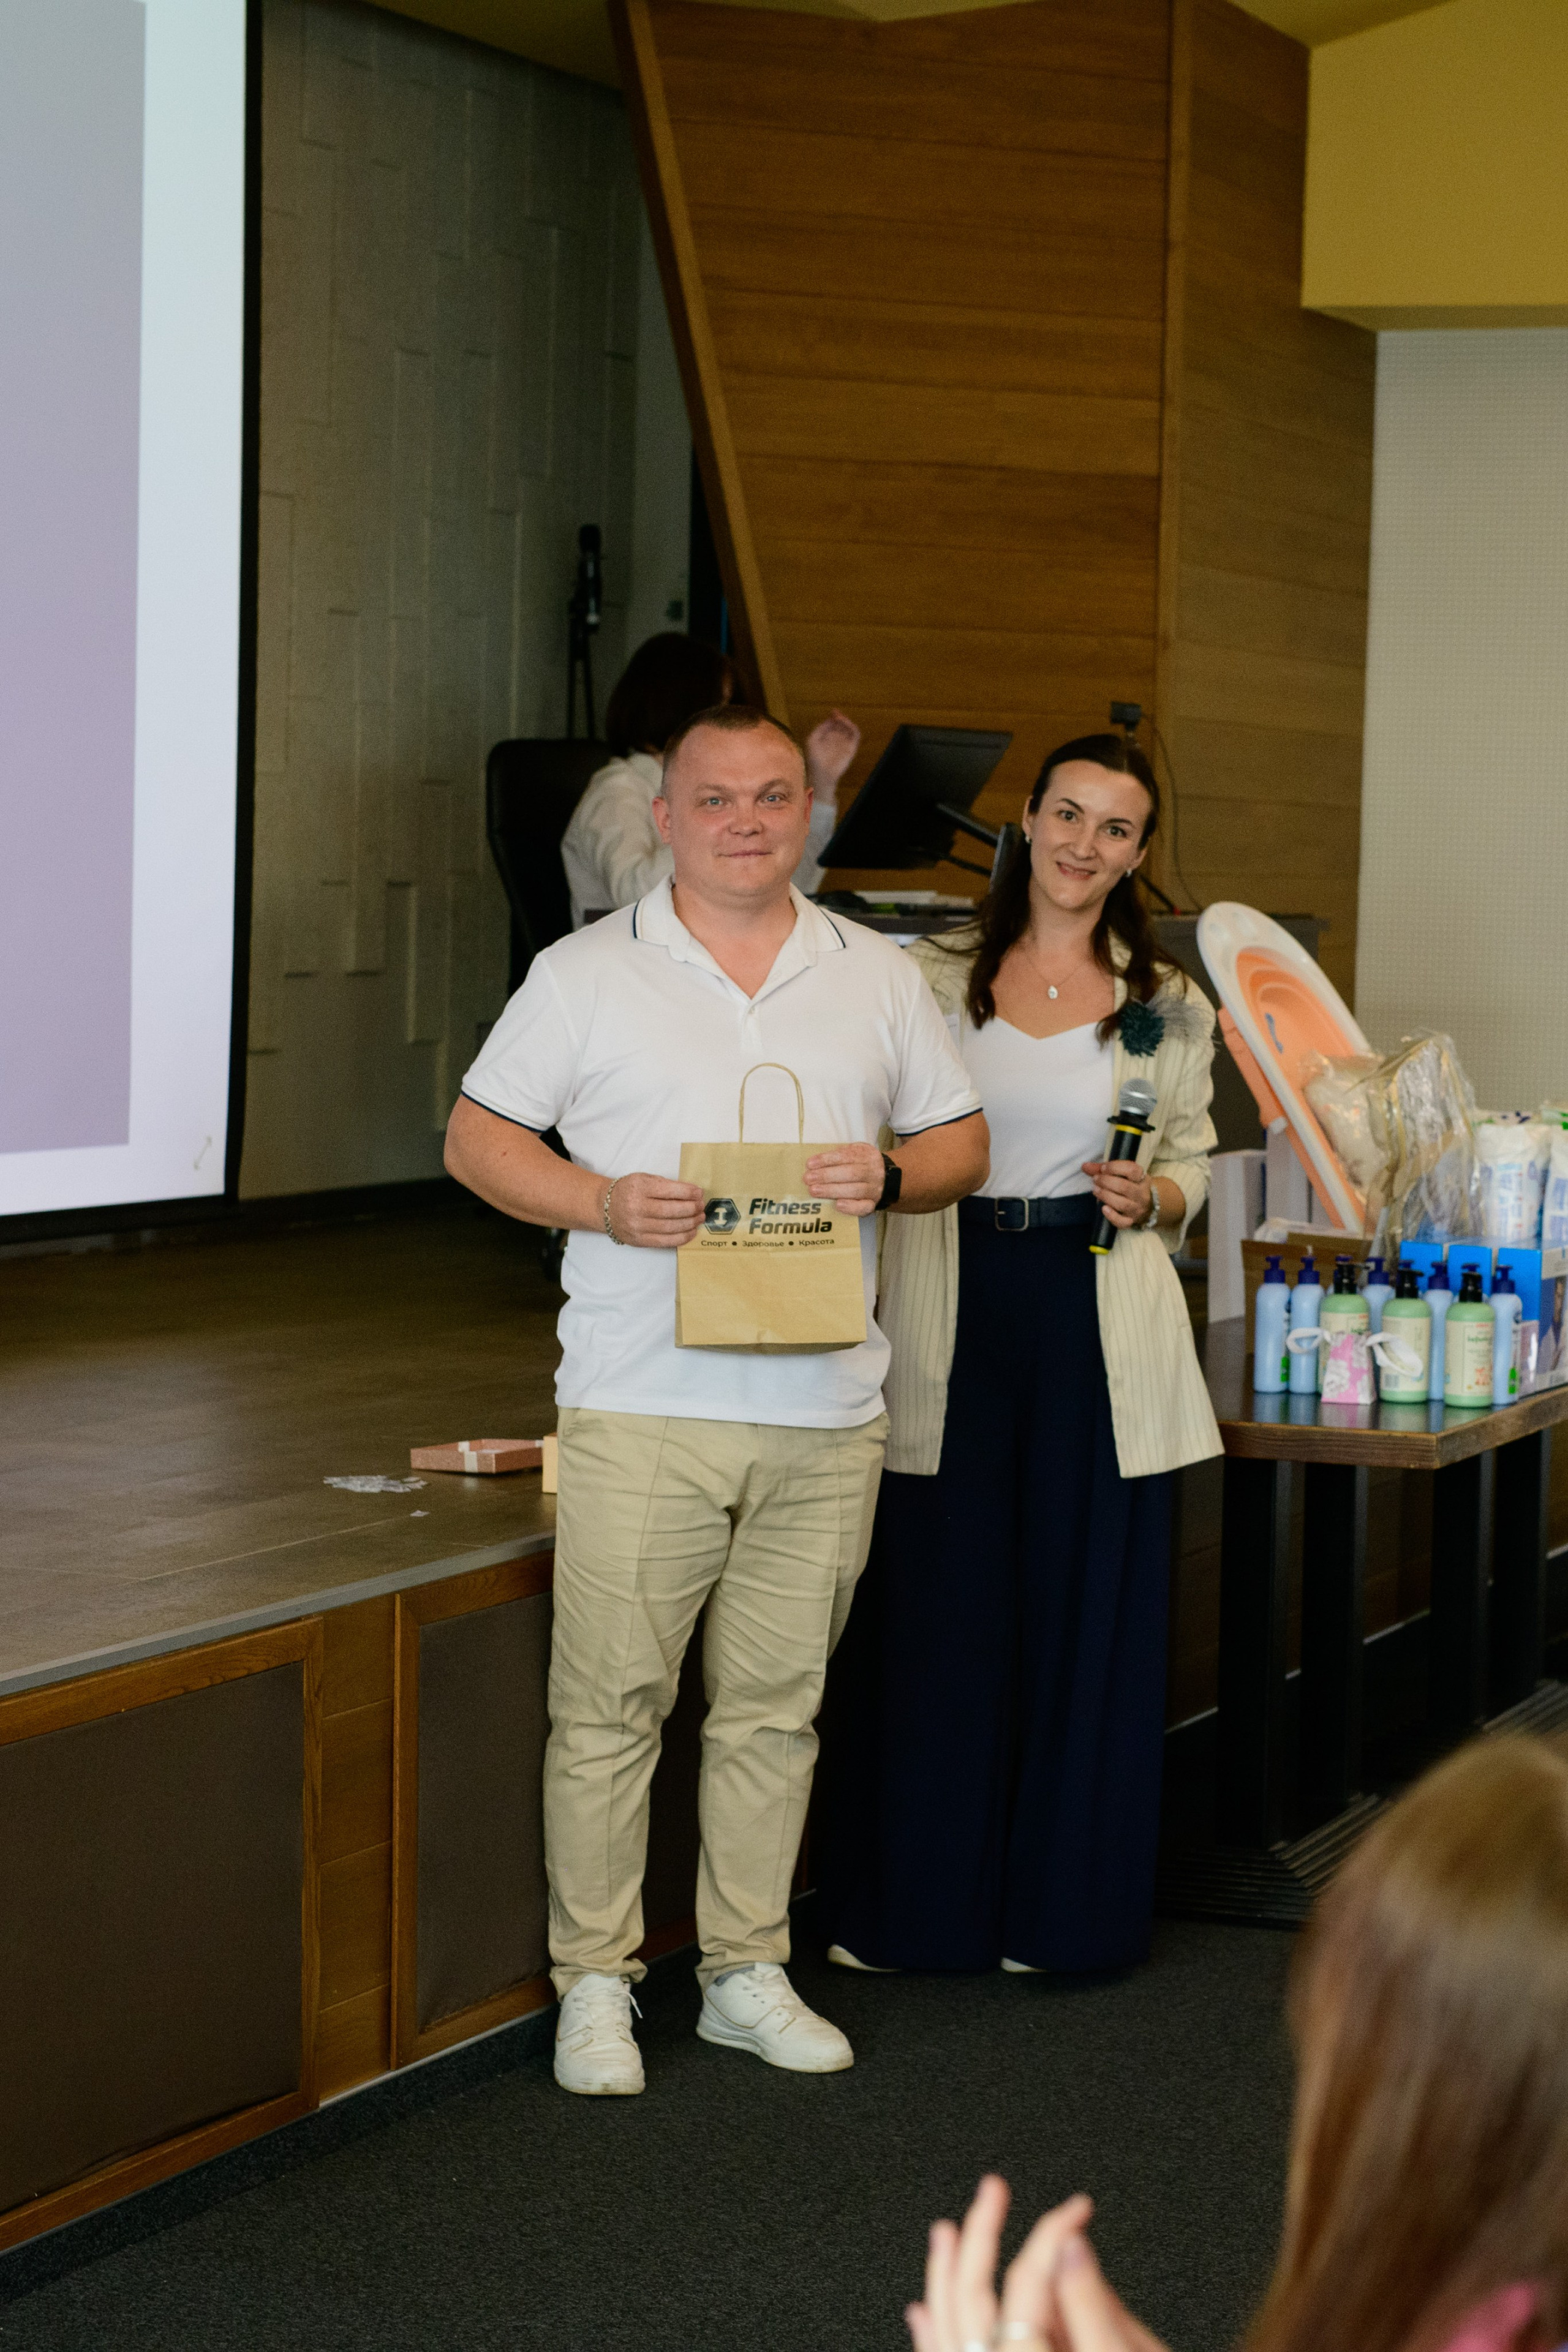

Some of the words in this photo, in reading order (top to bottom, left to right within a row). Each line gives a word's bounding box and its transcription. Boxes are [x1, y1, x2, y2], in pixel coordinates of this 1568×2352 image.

[748, 1198, 821, 1215] Fitness
[748, 1218, 832, 1235] Formula
[799, 1238, 835, 1247] Красота
